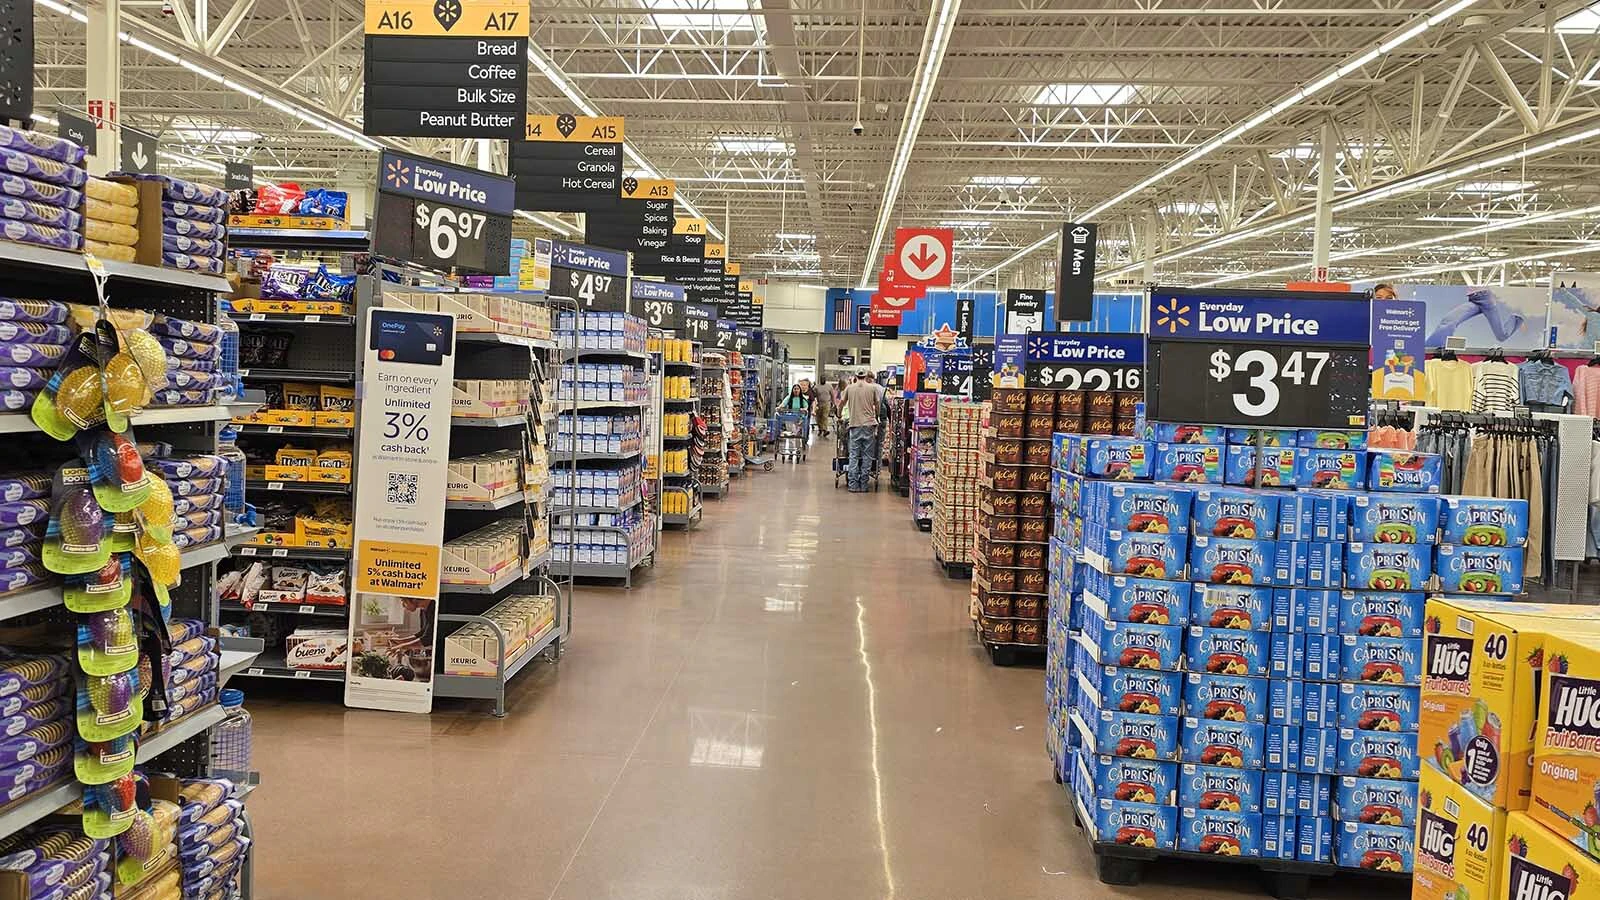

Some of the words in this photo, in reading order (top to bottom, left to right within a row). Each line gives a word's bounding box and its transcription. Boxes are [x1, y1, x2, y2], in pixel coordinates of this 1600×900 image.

[377, 11, 413, 30] A16
[484, 12, 519, 31] A17
[477, 41, 517, 56] Bread
[468, 64, 517, 80] Coffee
[457, 89, 487, 104] Bulk
[489, 90, 516, 104] Size
[420, 112, 467, 127] Peanut
[471, 113, 515, 128] Butter
[525, 124, 542, 137] 14
[591, 126, 617, 139] A15
[584, 145, 616, 157] Cereal
[415, 165, 443, 179] Everyday
[577, 161, 615, 173] Granola
[413, 174, 447, 196] Low
[449, 181, 487, 204] Price
[562, 178, 580, 189] Hot
[583, 178, 615, 190] Cereal
[650, 186, 668, 196] A13
[646, 201, 668, 212] Sugar
[644, 213, 668, 223] Spices
[643, 226, 667, 237] Baking
[687, 224, 700, 233] A11
[637, 238, 667, 249] Vinegar
[685, 235, 701, 245] Soup
[568, 253, 587, 266] Low
[588, 256, 610, 270] Price
[661, 255, 675, 264] Rice
[676, 255, 681, 264] &
[682, 256, 700, 264] Beans
[1072, 248, 1085, 276] Men
[644, 288, 656, 298] Low
[657, 289, 674, 299] Price
[1014, 300, 1038, 309] Jewelry
[1199, 302, 1244, 314] Everyday
[1199, 312, 1252, 333] Low
[1256, 313, 1319, 336] Price
[1053, 345, 1084, 358] Low
[1088, 345, 1125, 359] Price
[378, 373, 398, 383] Earn
[399, 376, 412, 384] on
[413, 377, 439, 386] every
[1209, 348, 1331, 417] $347
[385, 384, 432, 396] ingredient
[385, 398, 430, 410] Unlimited
[384, 411, 428, 441] 3%
[381, 444, 404, 454] cash
[1306, 457, 1342, 471] CAPRIS
[375, 558, 421, 570] Unlimited
[444, 565, 470, 574] KEURIG
[367, 568, 382, 578] 5%
[382, 570, 404, 579] cash
[404, 571, 427, 581] back
[370, 578, 380, 587] at
[295, 646, 326, 658] bueno
[1484, 633, 1508, 661] 40
[451, 657, 477, 666] KEURIG
[1431, 644, 1470, 676] HUG
[1578, 686, 1596, 695] Little
[1476, 739, 1488, 750] Only
[1541, 760, 1578, 782] Original
[1423, 819, 1454, 857] HUG
[1466, 823, 1489, 853] 40
[1536, 873, 1553, 887] Little
